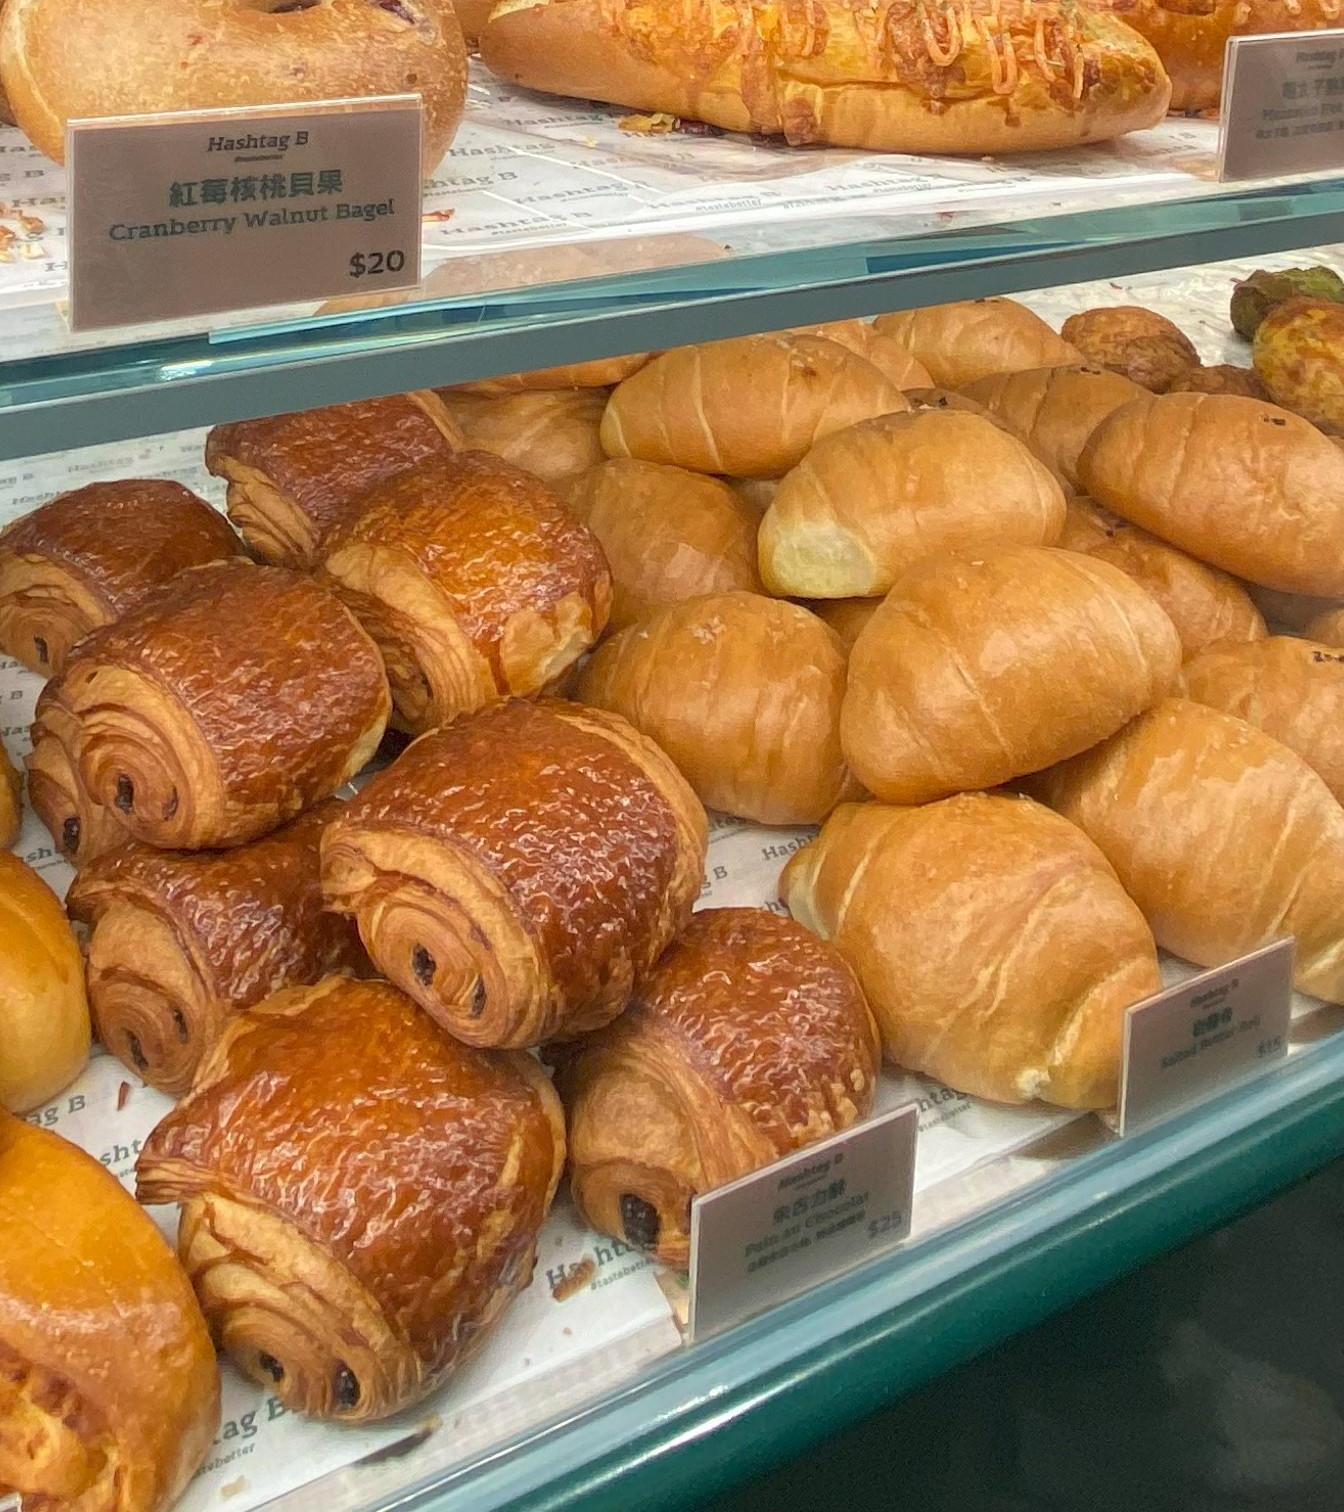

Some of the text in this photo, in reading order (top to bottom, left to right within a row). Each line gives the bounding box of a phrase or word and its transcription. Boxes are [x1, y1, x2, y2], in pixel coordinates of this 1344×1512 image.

[206, 131, 309, 154] Hashtag B
[423, 175, 494, 188] htag
[109, 198, 395, 242] Cranberry Walnut Bagel
[349, 249, 405, 278] $20
[762, 833, 819, 861] Hash
[713, 865, 728, 881] B
[68, 1095, 86, 1114] B
